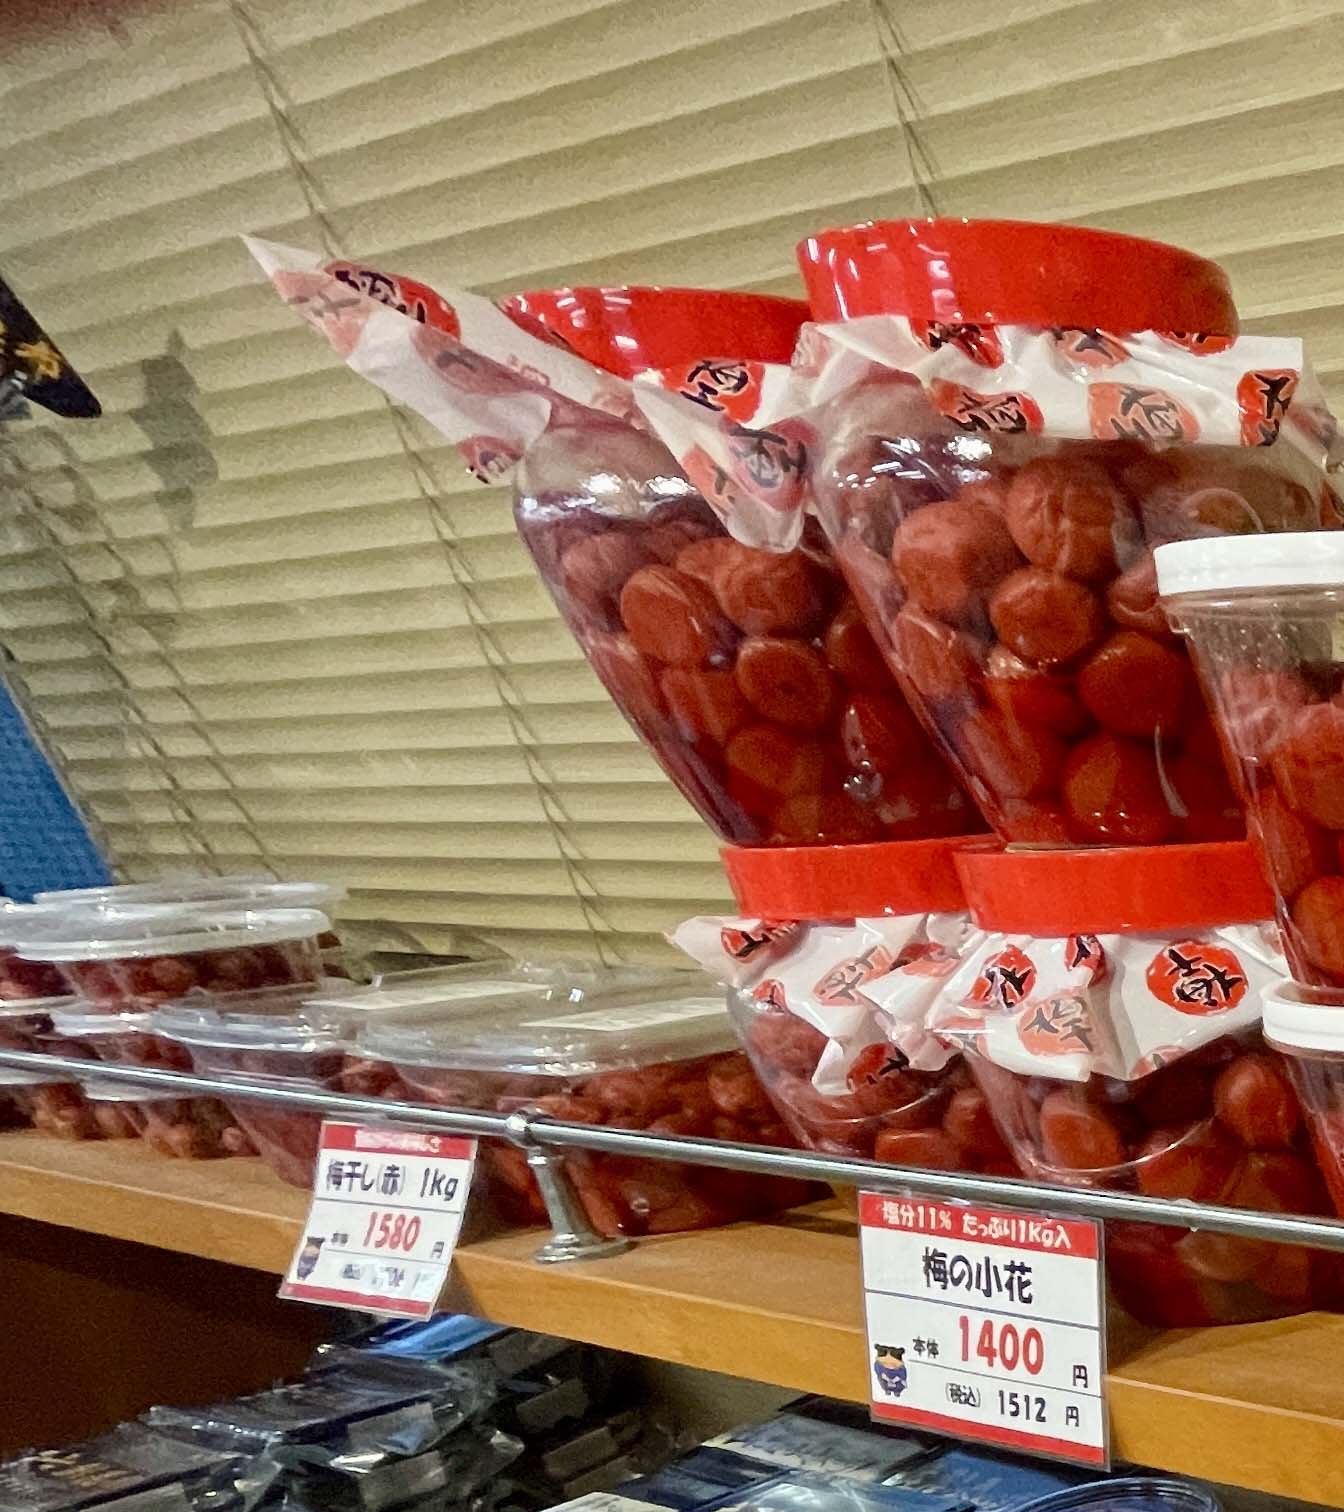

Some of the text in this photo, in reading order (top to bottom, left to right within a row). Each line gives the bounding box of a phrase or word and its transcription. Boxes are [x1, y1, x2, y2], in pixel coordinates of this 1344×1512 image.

[362, 1211, 421, 1252] 1580
[882, 1201, 952, 1231] 塩分11%
[922, 1246, 1033, 1305] 梅の小花
[912, 1314, 1089, 1389] 本体 1400 円
[945, 1381, 1080, 1428] (税込) 1512 円
